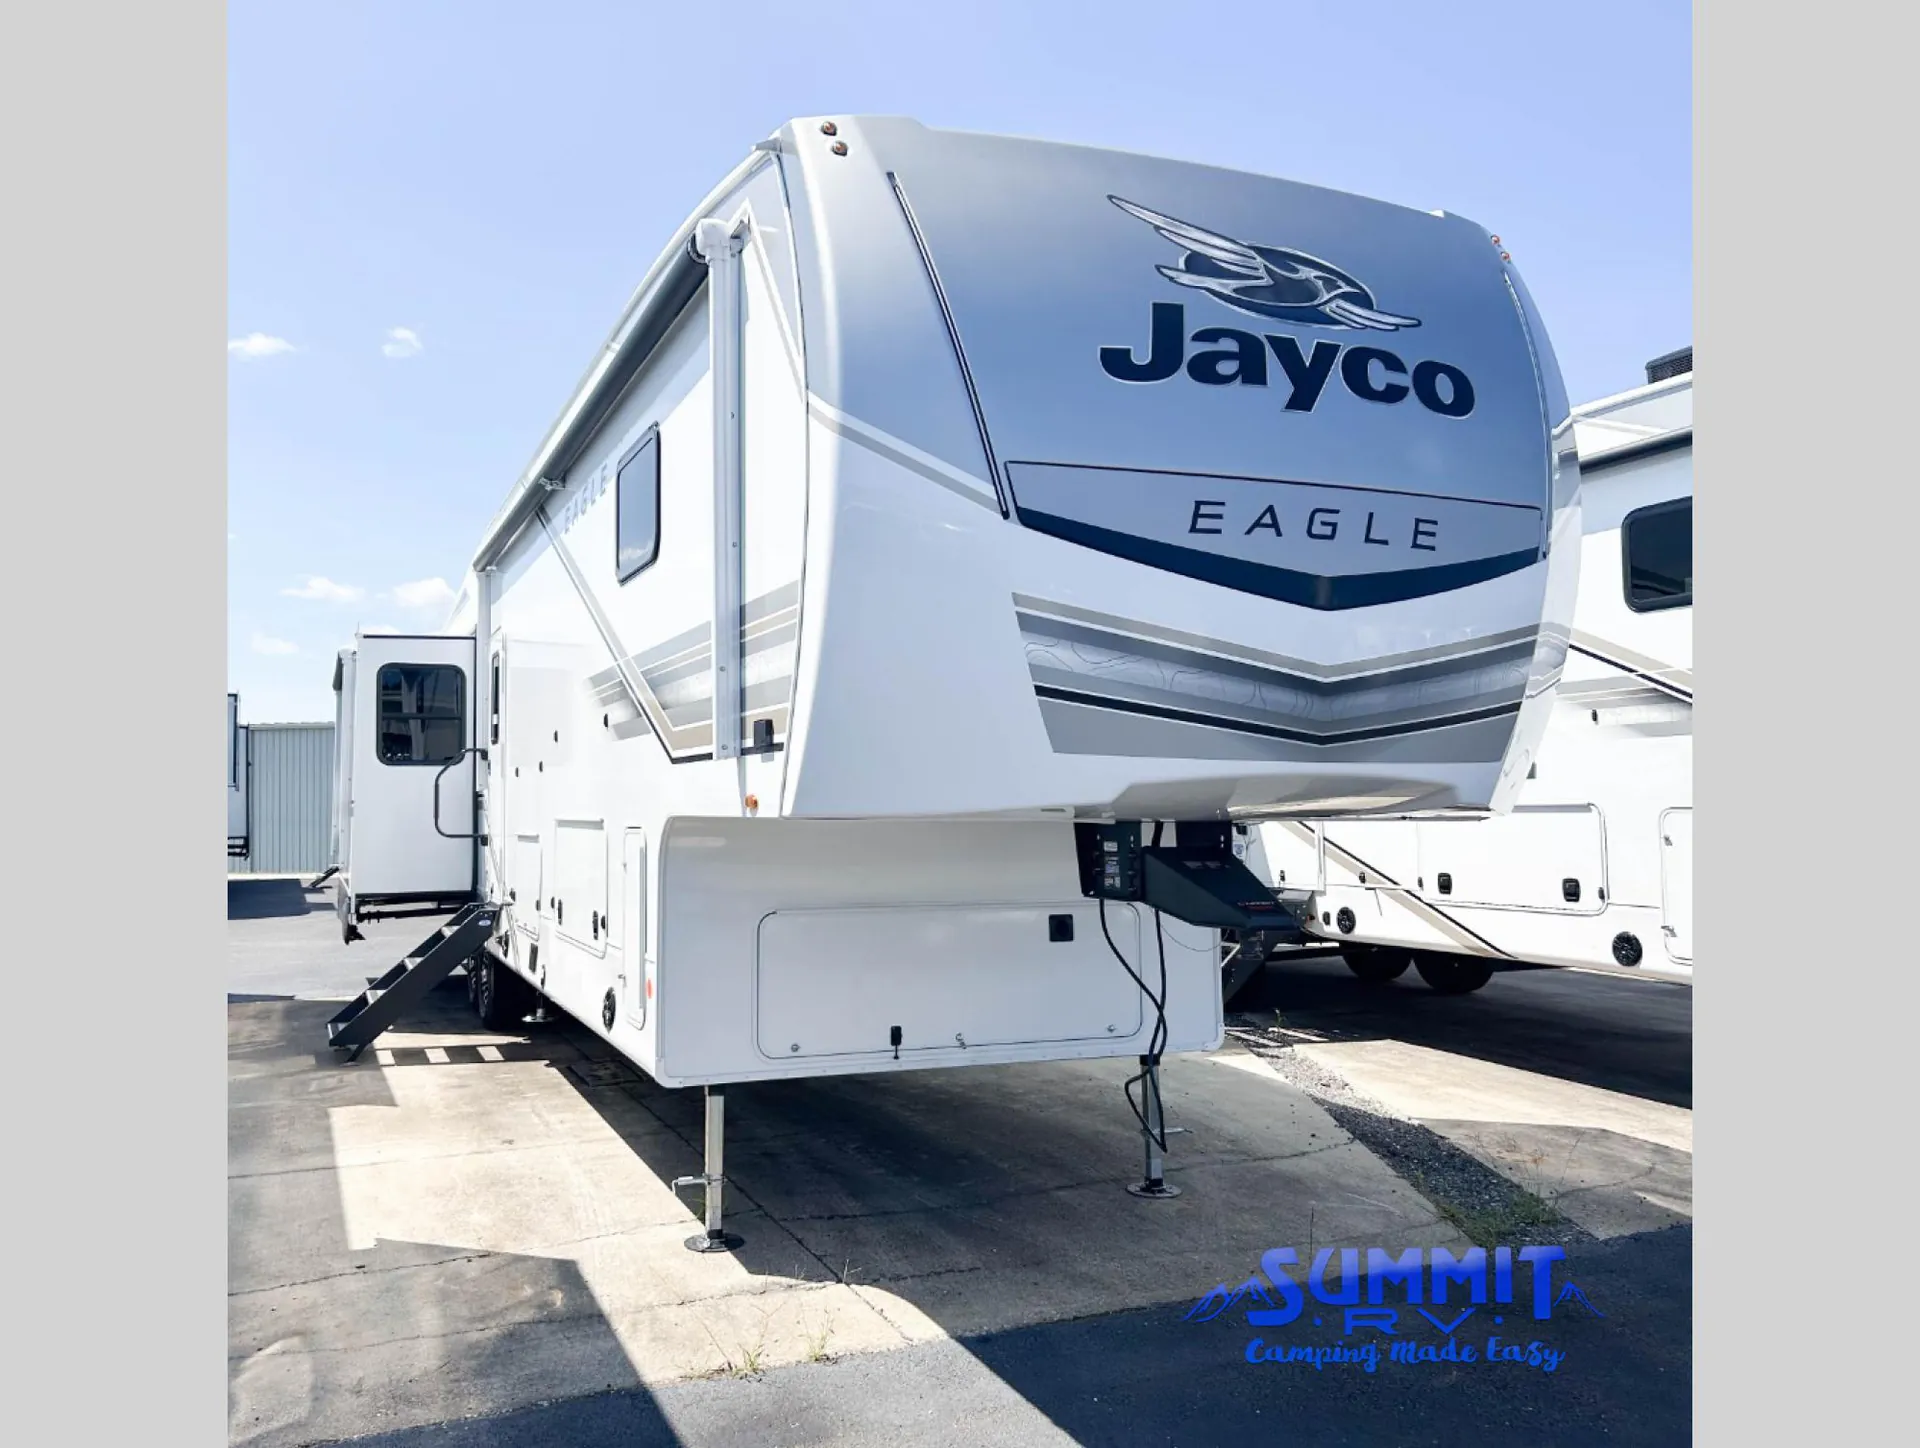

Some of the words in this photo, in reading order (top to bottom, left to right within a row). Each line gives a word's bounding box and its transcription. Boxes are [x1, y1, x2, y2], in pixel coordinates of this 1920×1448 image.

[1098, 302, 1476, 420] Jayco
[564, 461, 608, 535] EAGLE
[1188, 500, 1439, 552] EAGLE
